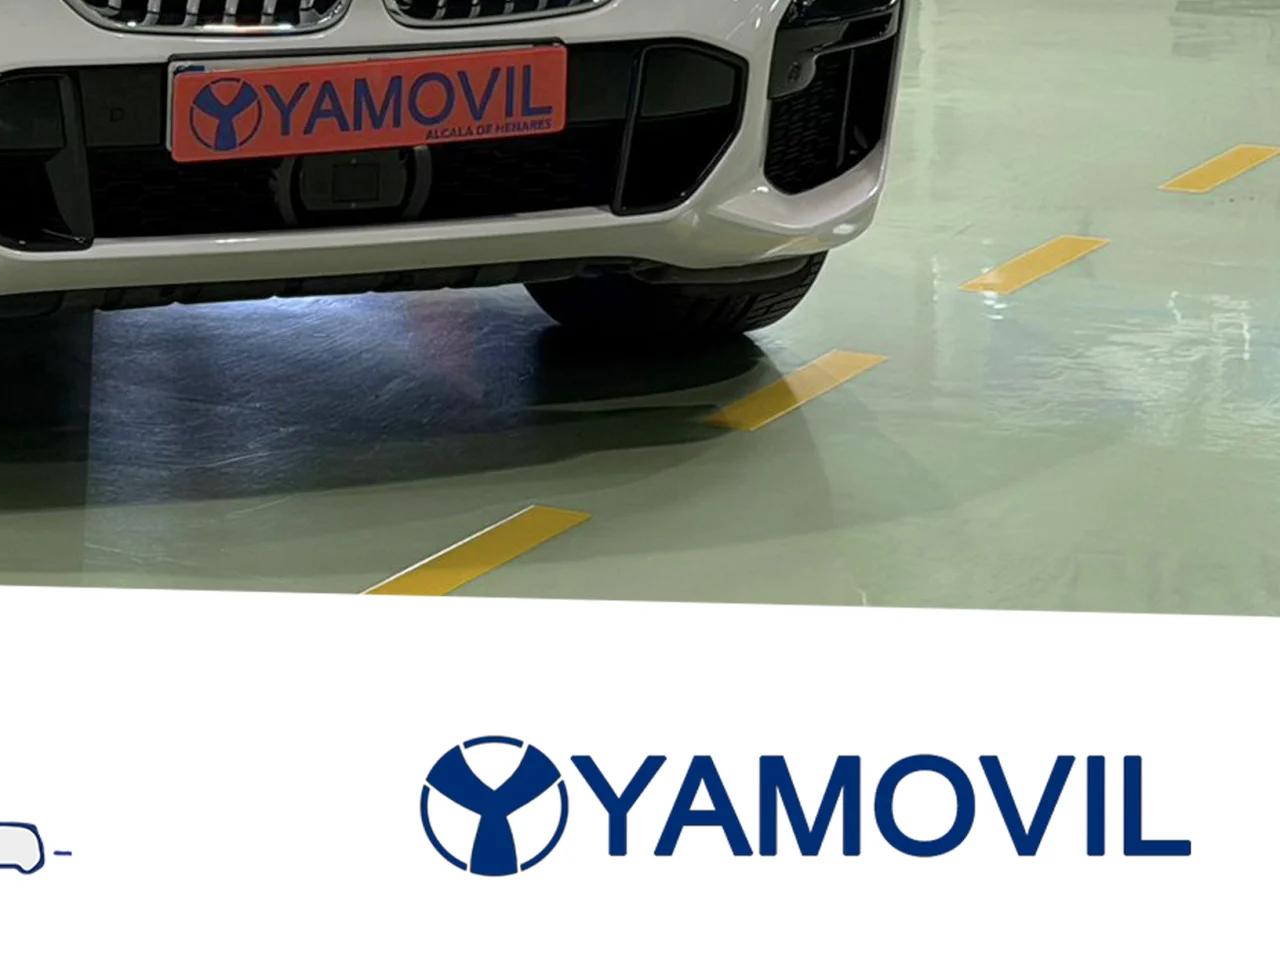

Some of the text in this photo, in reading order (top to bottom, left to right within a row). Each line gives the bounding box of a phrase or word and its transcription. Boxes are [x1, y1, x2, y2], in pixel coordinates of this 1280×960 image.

[263, 64, 553, 136] YAMOVIL
[476, 123, 493, 136] DE
[495, 118, 553, 134] HENARES
